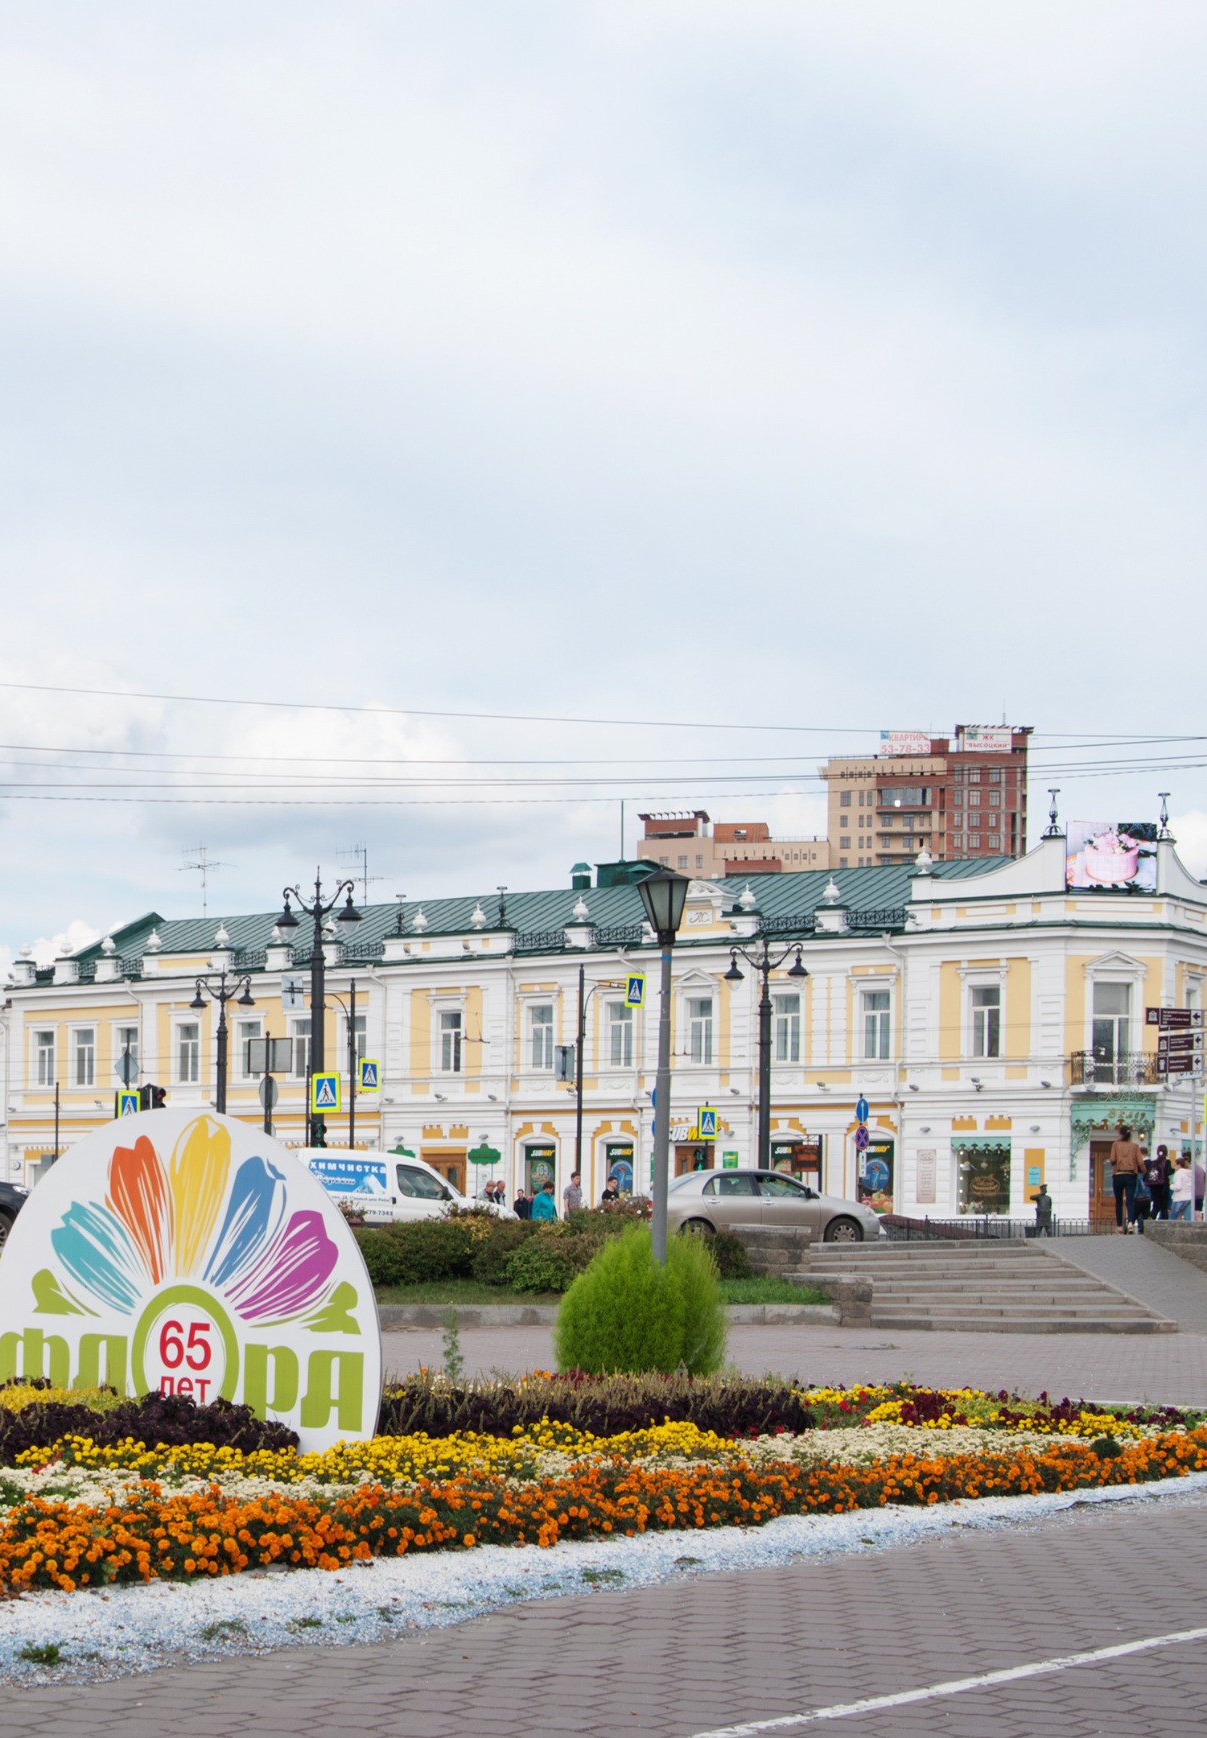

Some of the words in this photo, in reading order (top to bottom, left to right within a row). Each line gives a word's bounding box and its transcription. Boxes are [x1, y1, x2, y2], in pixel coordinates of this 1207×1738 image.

[881, 744, 930, 754] 53-78-33
[159, 1320, 212, 1371] 65
[159, 1376, 212, 1403] лет
